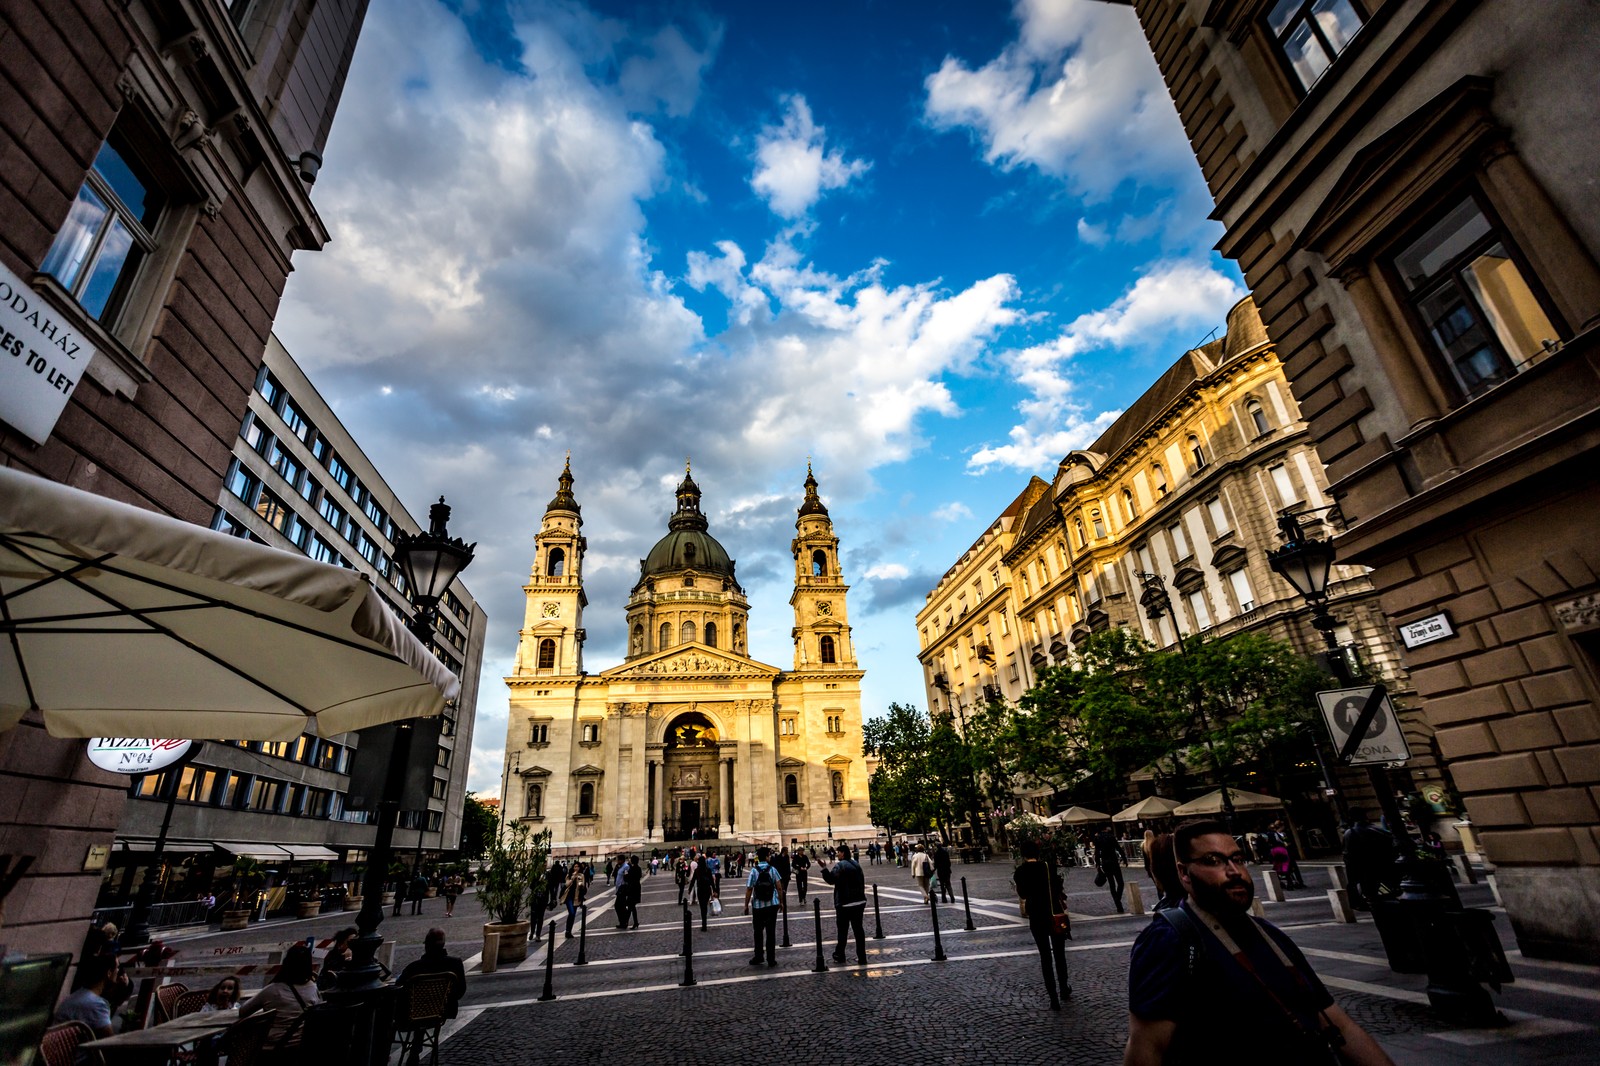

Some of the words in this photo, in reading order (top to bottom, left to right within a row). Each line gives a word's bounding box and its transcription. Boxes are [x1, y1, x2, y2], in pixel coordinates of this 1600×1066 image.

[0, 282, 80, 359] ODAHÁZ
[26, 349, 46, 374] TO
[47, 368, 74, 395] LET
